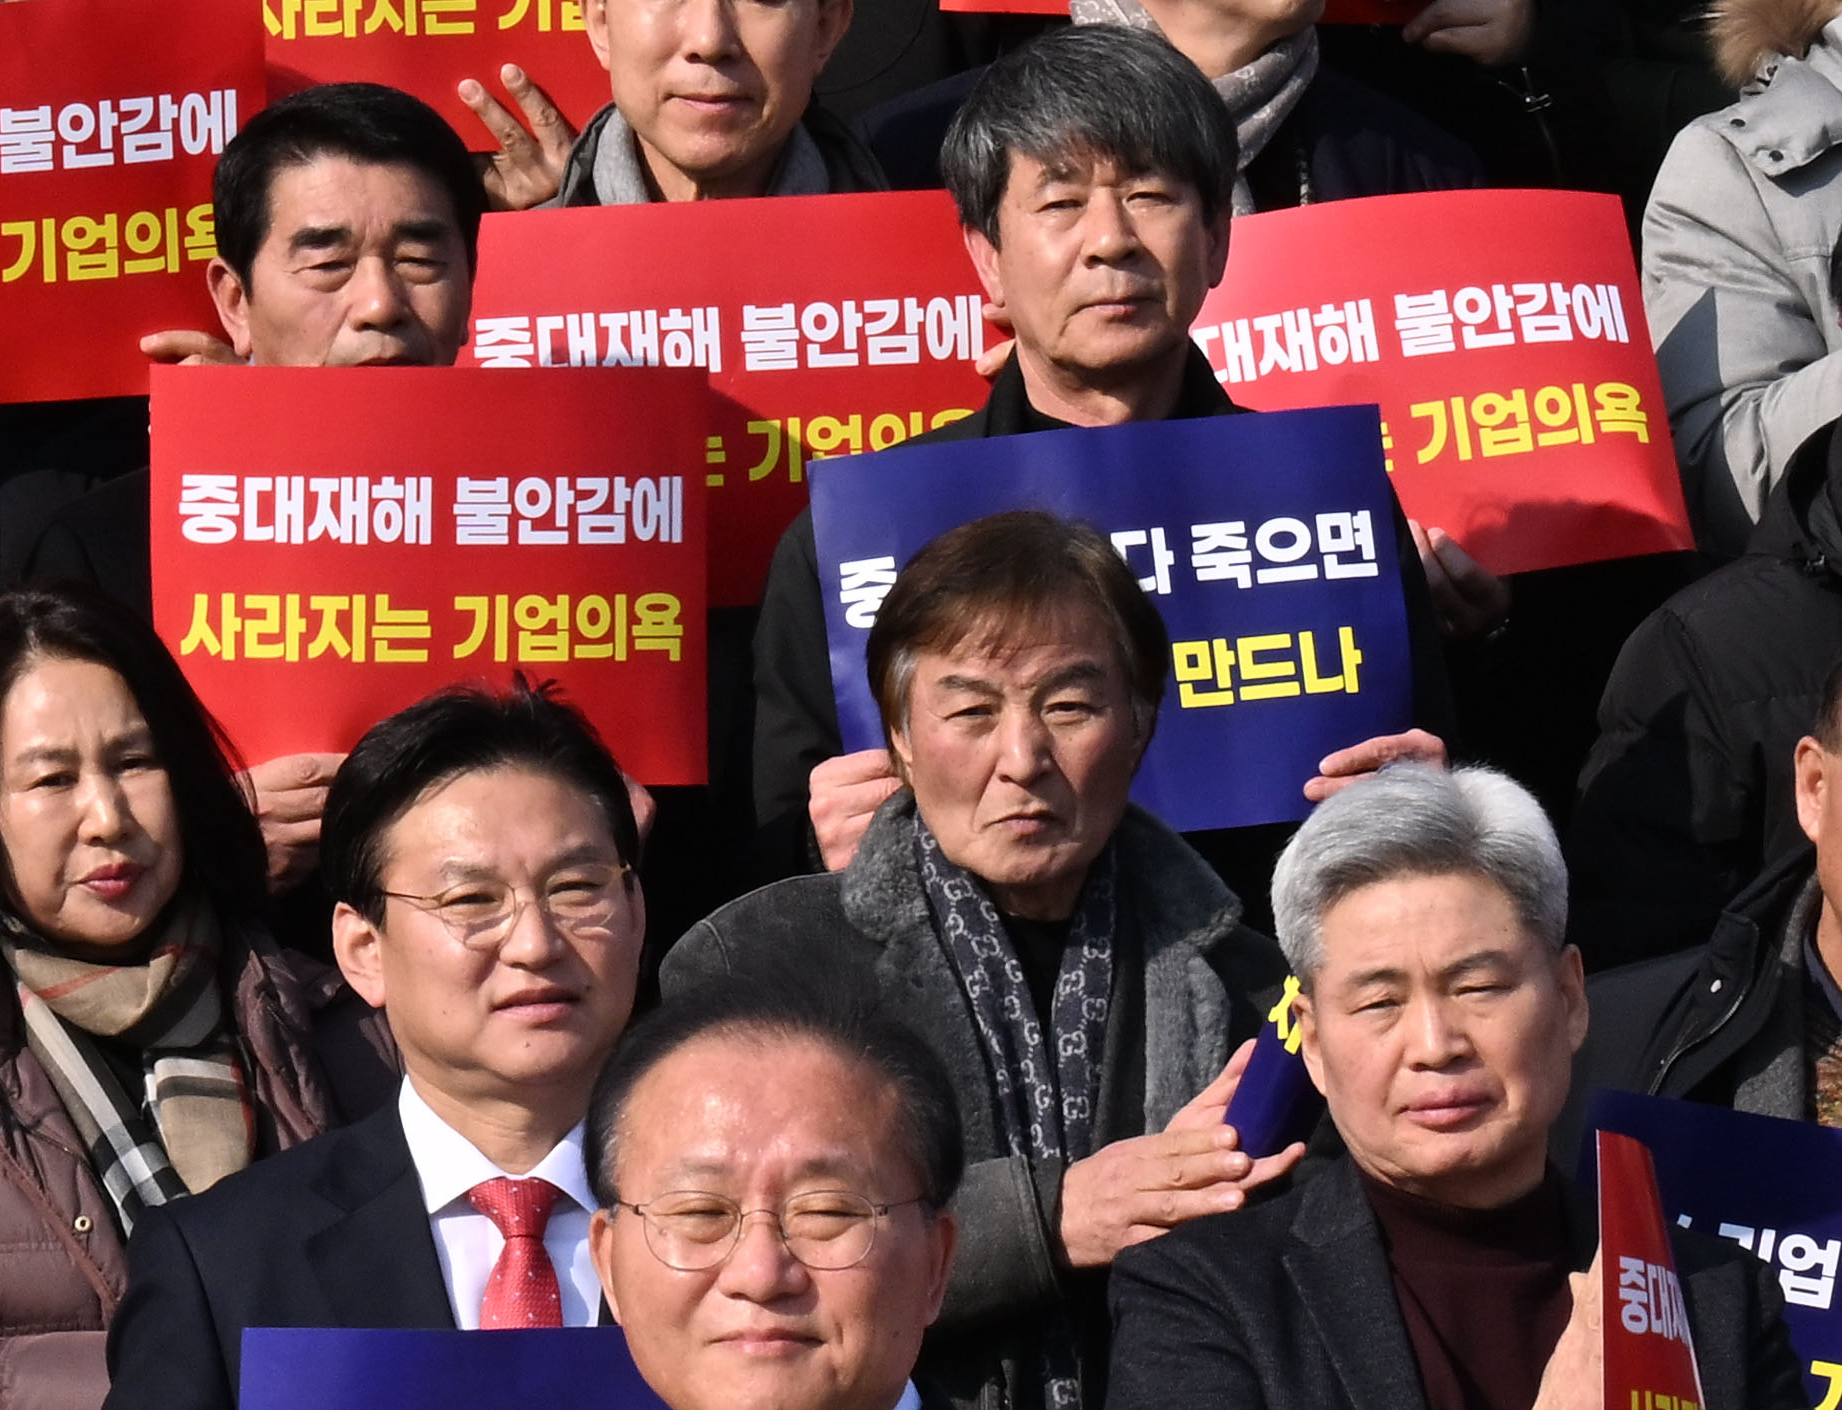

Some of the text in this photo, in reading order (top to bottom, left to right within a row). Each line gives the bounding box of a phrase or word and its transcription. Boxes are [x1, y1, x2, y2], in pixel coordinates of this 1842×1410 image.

[473, 294, 985, 374] 중대재해 불안감에
[1393, 281, 1630, 358] 불안감에
[1410, 382, 1650, 464] 기업의욕
[178, 473, 682, 546] 중대재해 불안감에
[1190, 509, 1379, 589] 죽으면
[180, 592, 684, 663] 사라지는 기업의욕
[1172, 627, 1363, 708] 만드나
